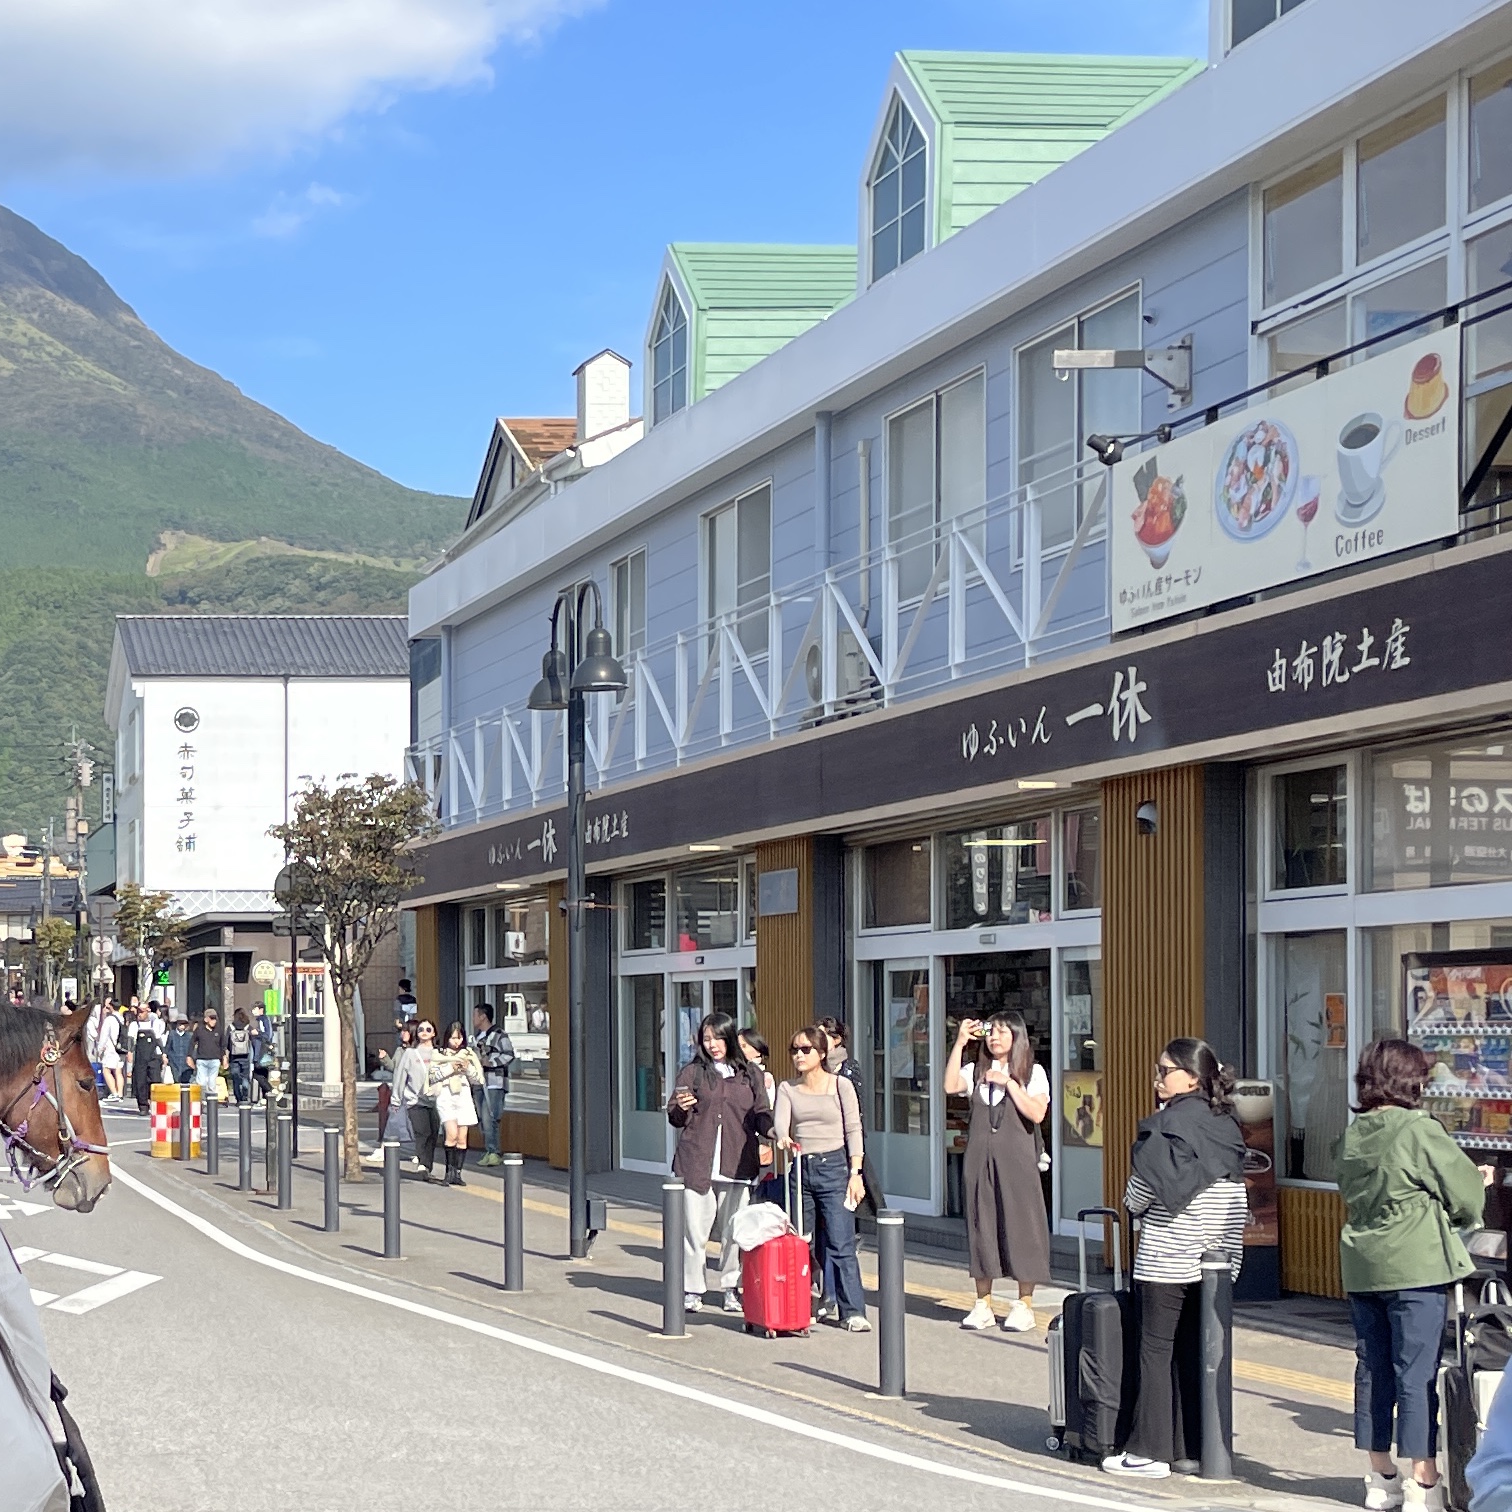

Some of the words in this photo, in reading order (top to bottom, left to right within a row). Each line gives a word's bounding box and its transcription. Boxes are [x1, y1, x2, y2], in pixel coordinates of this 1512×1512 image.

[1405, 417, 1446, 445] Dessert
[1335, 529, 1384, 557] Coffee
[1267, 618, 1411, 692] 由布院土産
[962, 705, 1052, 761] ゆふいん
[1065, 666, 1152, 742] 一休
[527, 818, 558, 864] 一休
